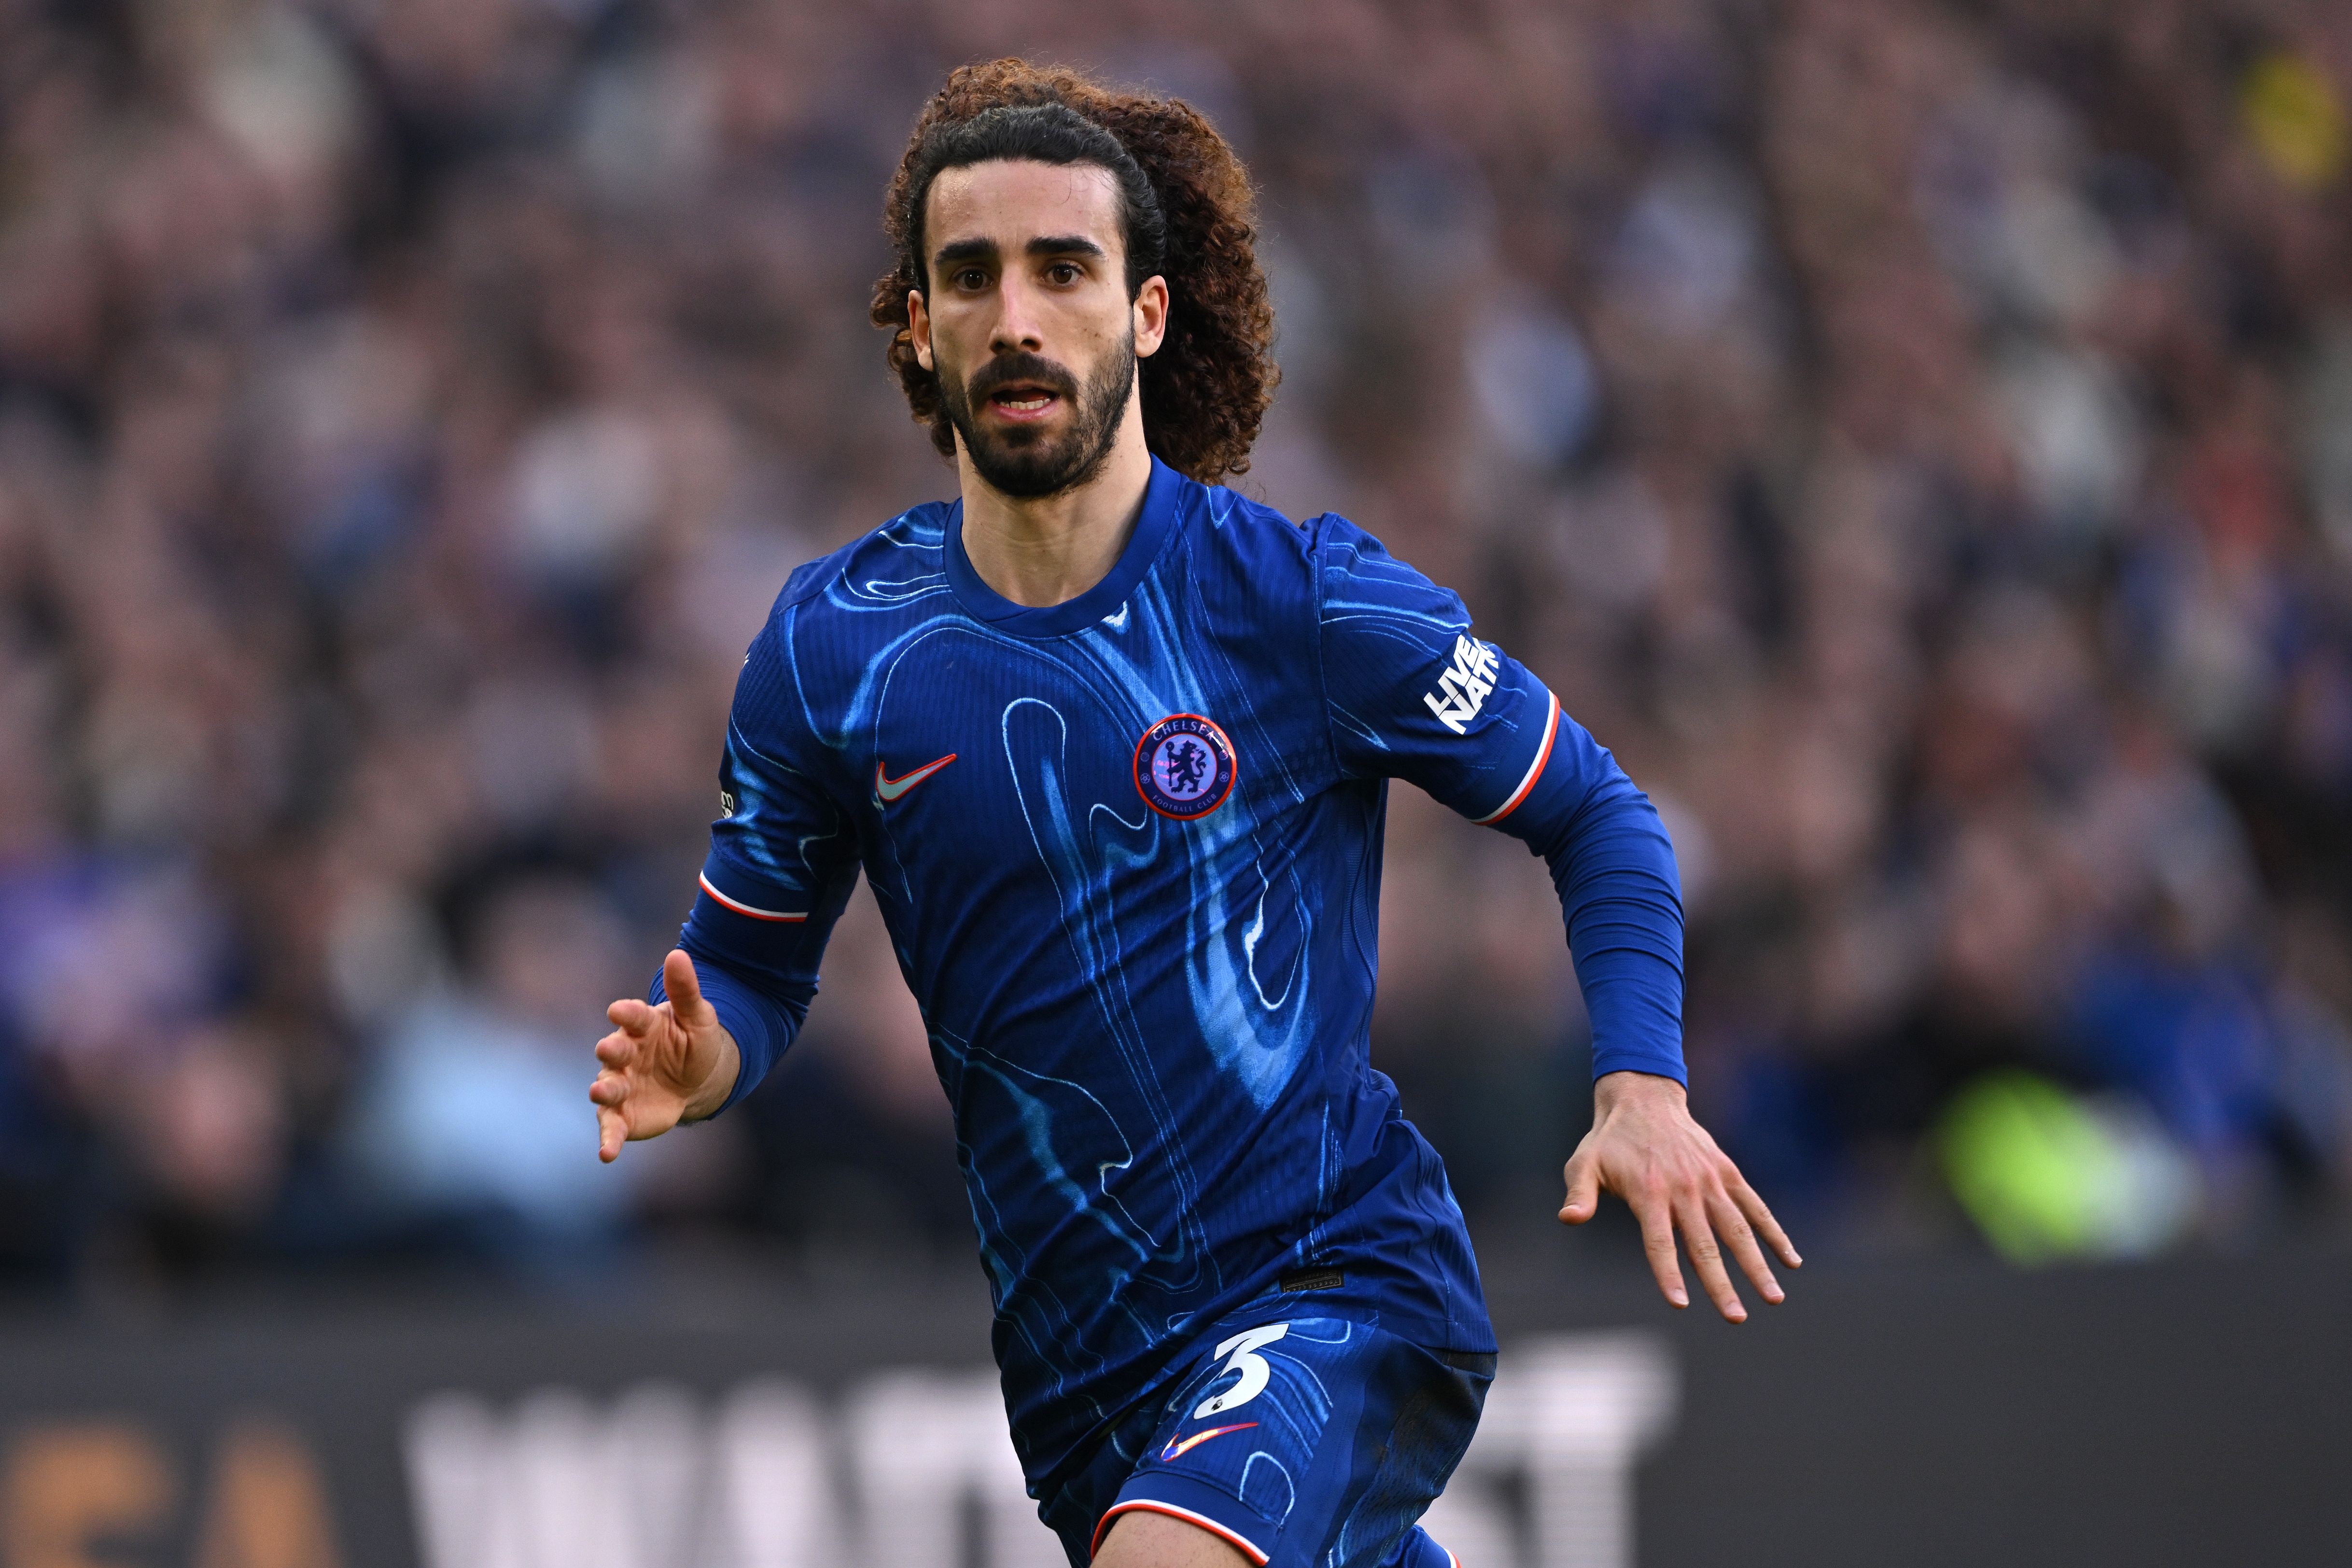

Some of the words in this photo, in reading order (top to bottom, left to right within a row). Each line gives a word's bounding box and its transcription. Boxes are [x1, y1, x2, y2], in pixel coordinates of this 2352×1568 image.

[1423, 634, 1480, 717] LIVE
[1153, 720, 1215, 741] CHELSEA
[1152, 794, 1193, 812] FOOTBALL
[1197, 793, 1217, 810] CLUB
[1193, 1323, 1290, 1420] 3
